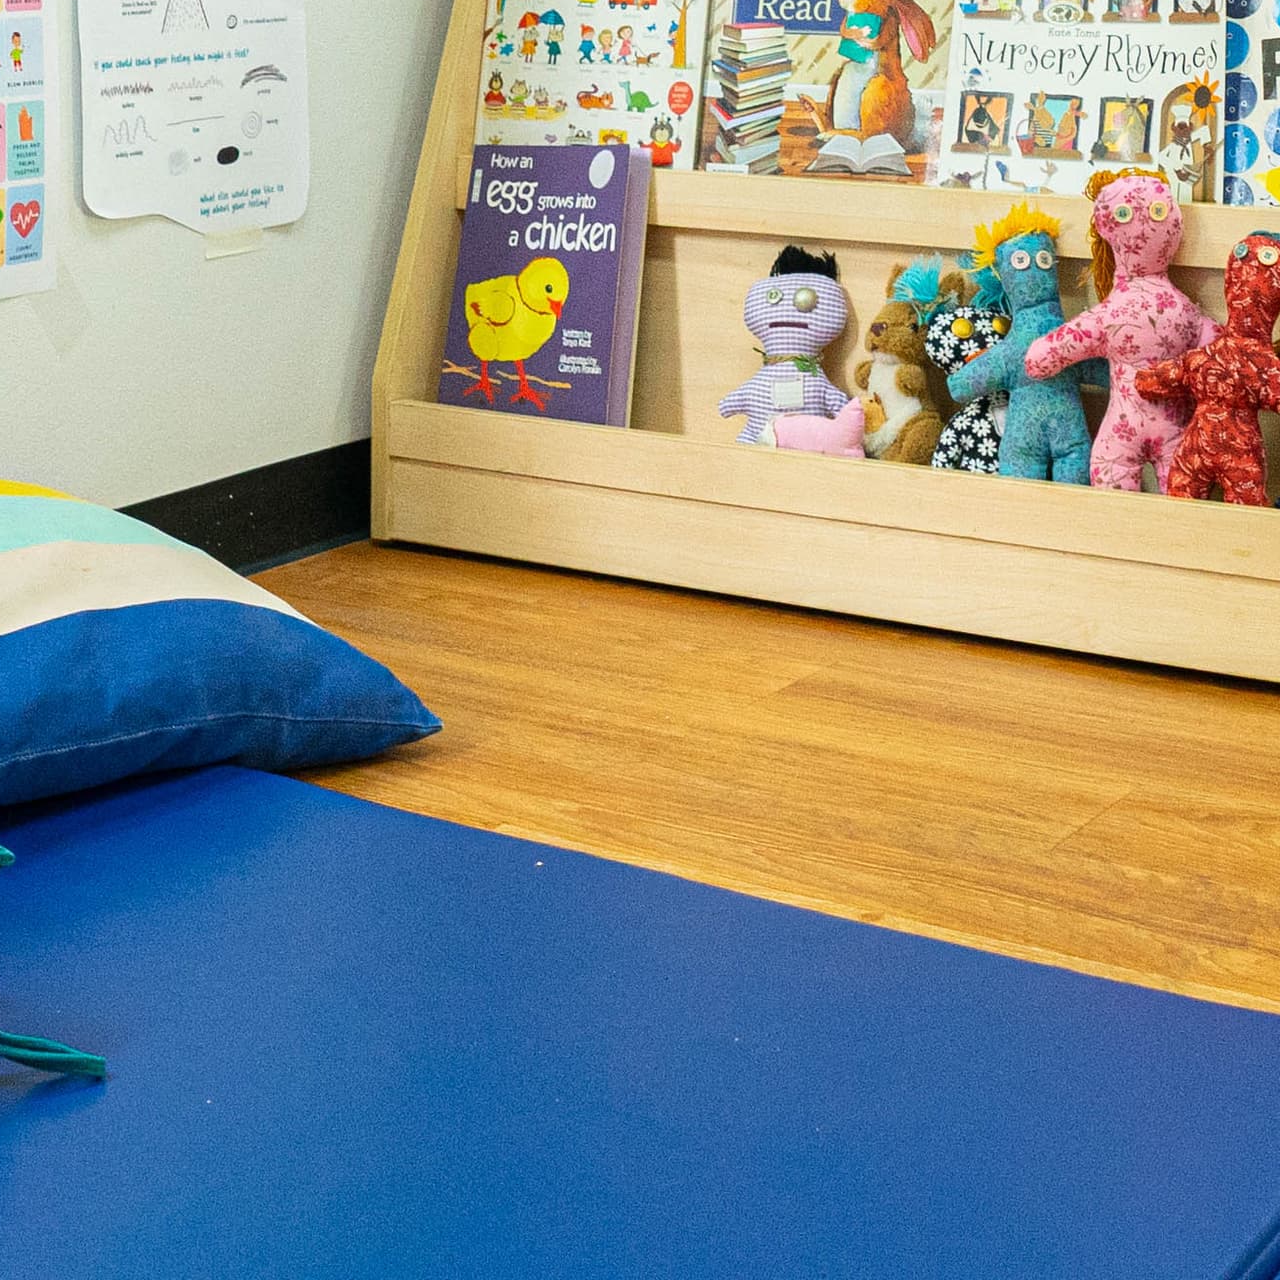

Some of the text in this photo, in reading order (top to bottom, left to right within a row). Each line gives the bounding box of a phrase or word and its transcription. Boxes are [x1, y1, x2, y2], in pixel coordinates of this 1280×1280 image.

[962, 31, 1219, 86] Nursery Rhymes
[491, 152, 533, 169] How an
[486, 179, 597, 215] egg grows into
[508, 213, 617, 253] a chicken
